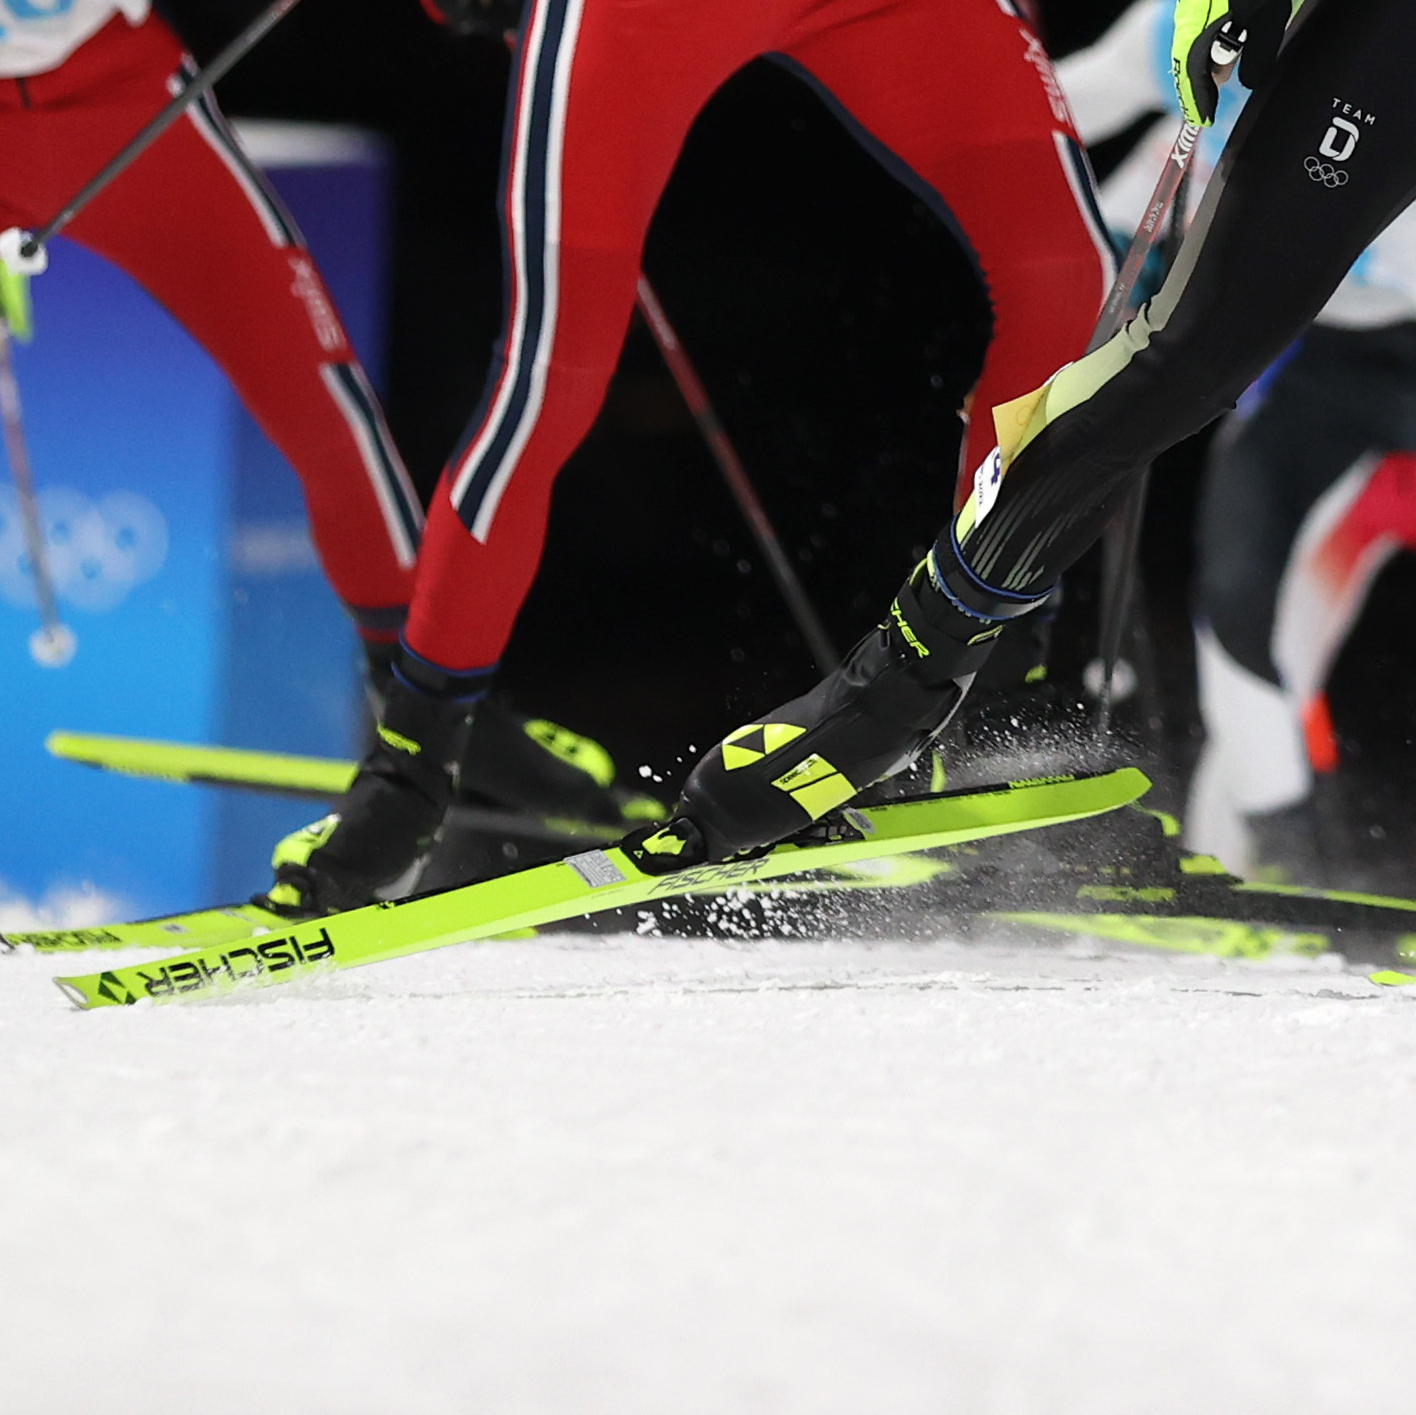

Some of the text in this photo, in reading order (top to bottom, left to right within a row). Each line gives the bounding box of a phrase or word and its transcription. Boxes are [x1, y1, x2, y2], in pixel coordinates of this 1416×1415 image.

[1332, 97, 1376, 126] TEAM
[890, 596, 931, 659] CHER
[647, 857, 769, 895] FISCHER
[134, 927, 335, 997] FISCHER
